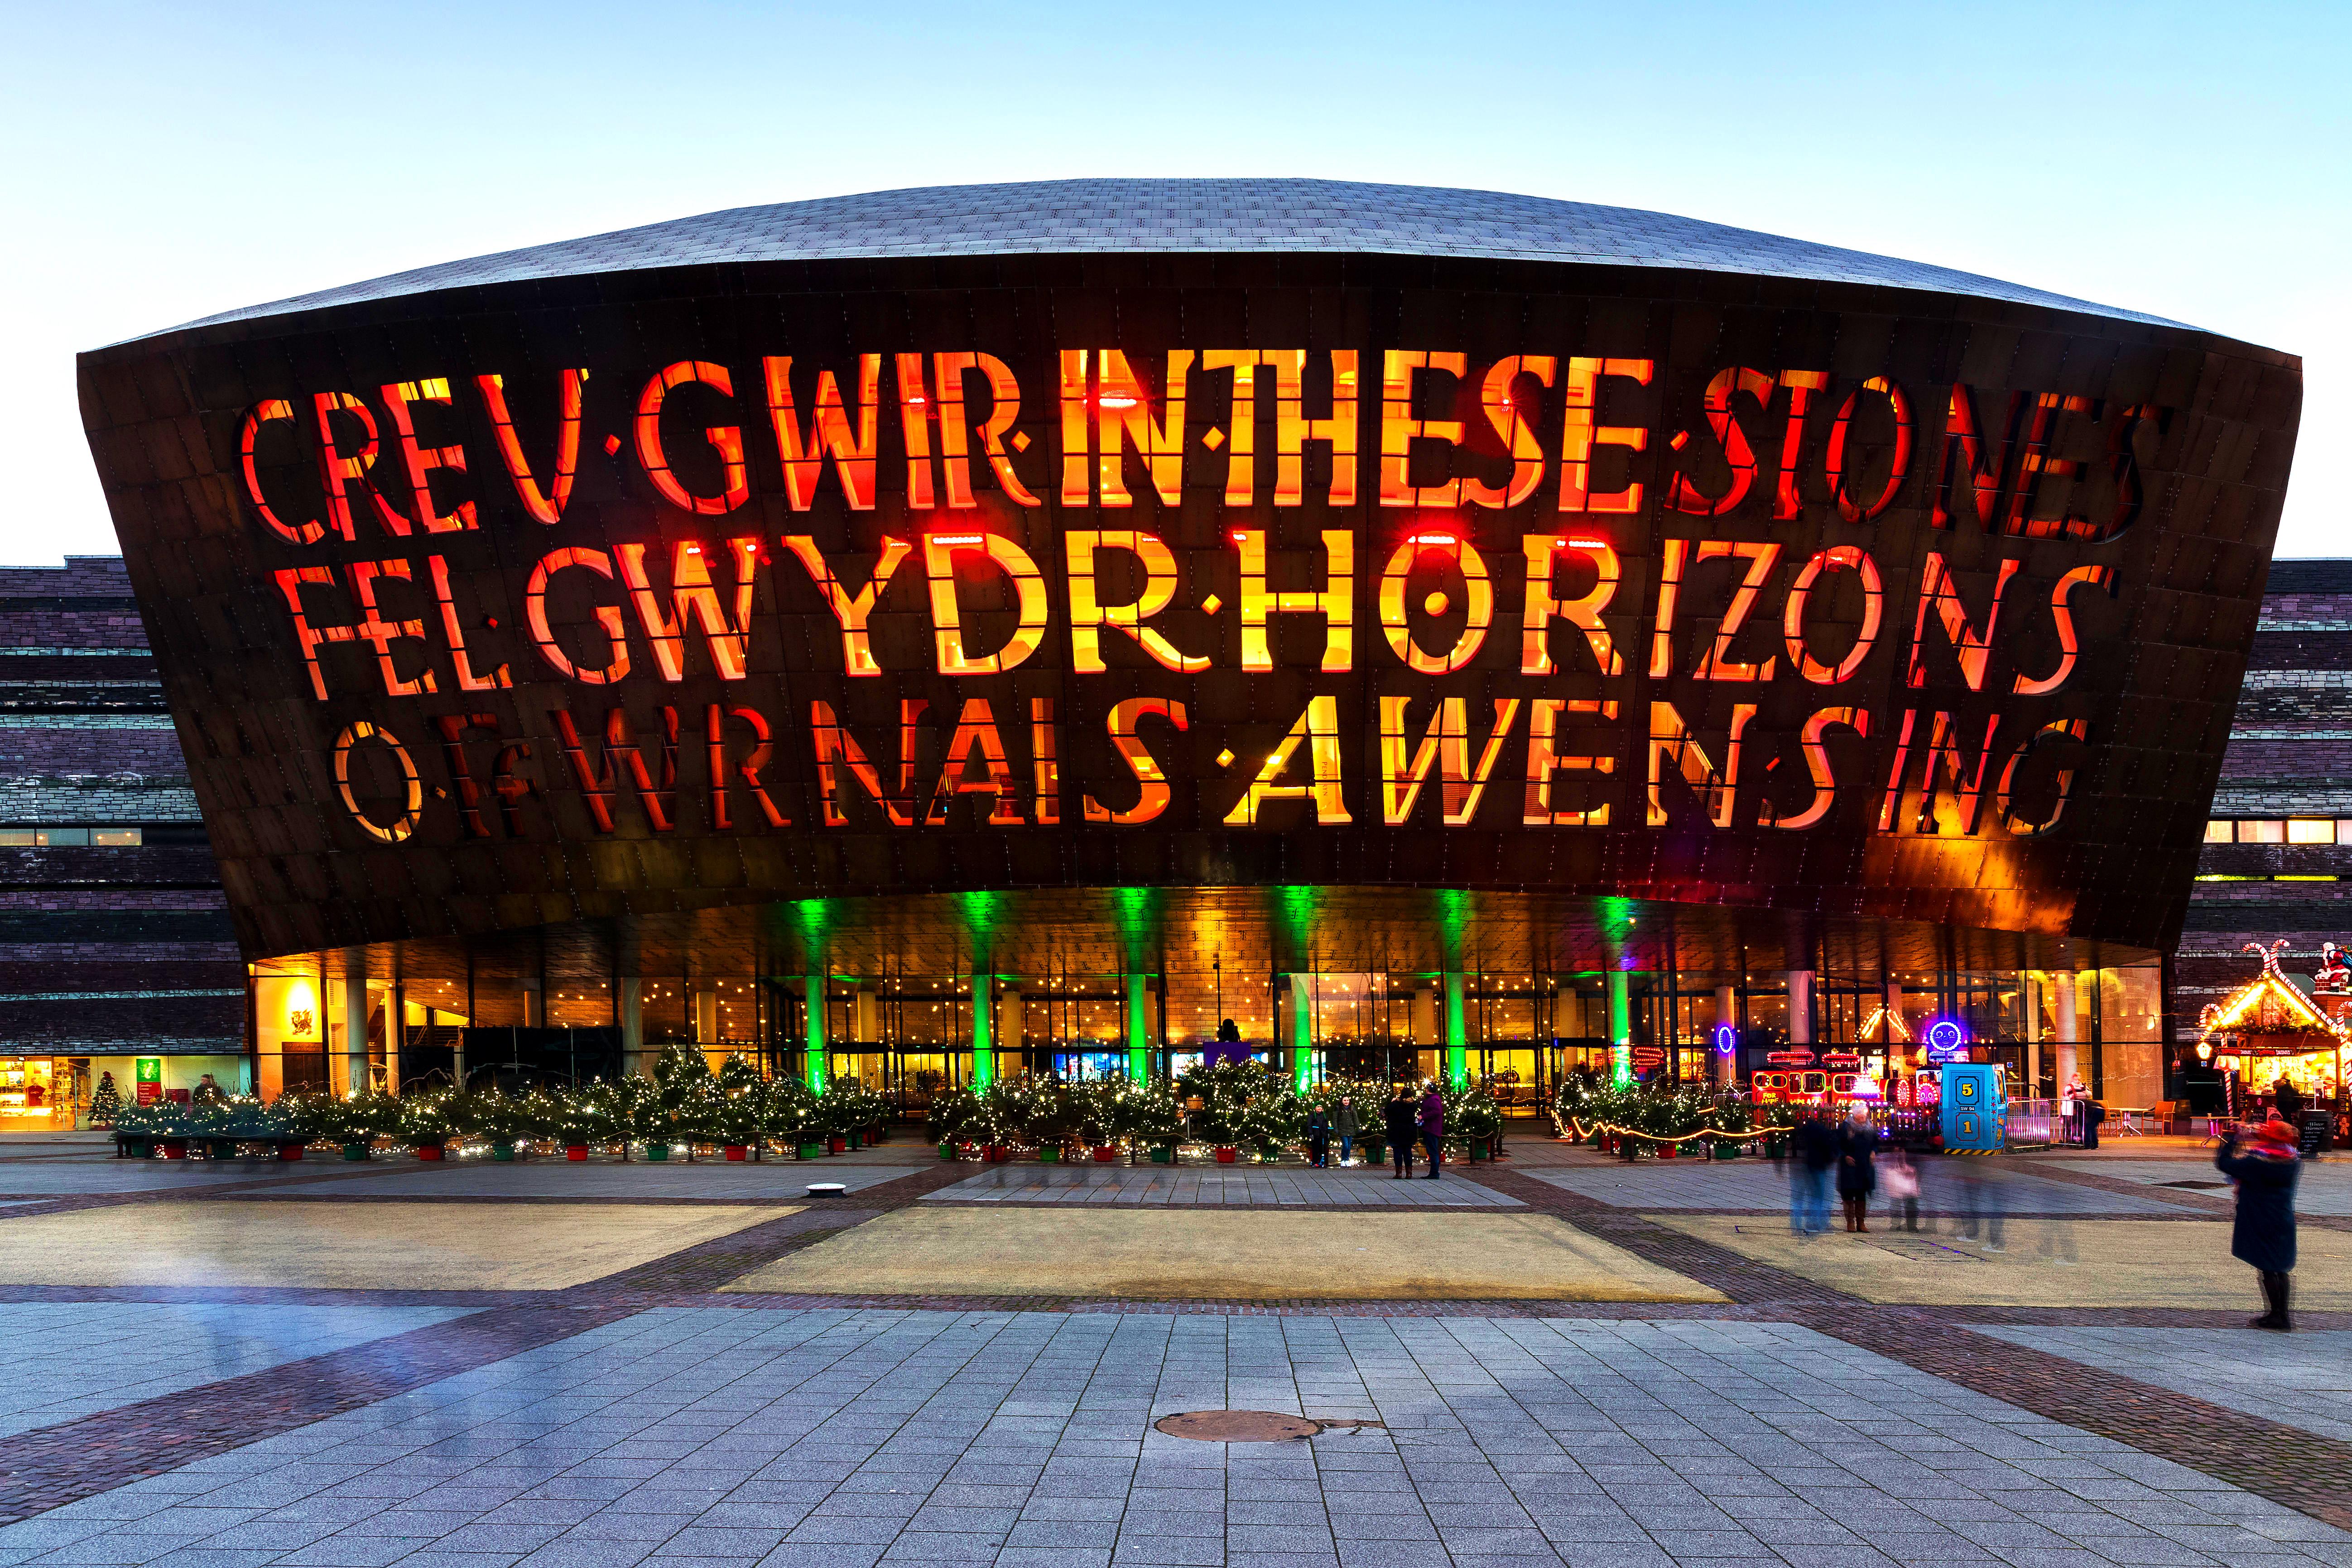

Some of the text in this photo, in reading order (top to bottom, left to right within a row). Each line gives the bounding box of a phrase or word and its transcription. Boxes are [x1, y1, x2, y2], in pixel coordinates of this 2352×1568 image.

[633, 351, 1041, 515] GWIR
[1060, 349, 1195, 507] IN
[1202, 349, 1654, 513] THESE
[1663, 366, 2174, 544] STONES
[268, 530, 2121, 702] FEL GWYDR HORIZONS
[1223, 696, 1758, 830] AWEN
[1758, 707, 2092, 839] SING
[1962, 1083, 1973, 1096] 5
[1963, 1121, 1972, 1133] 1
